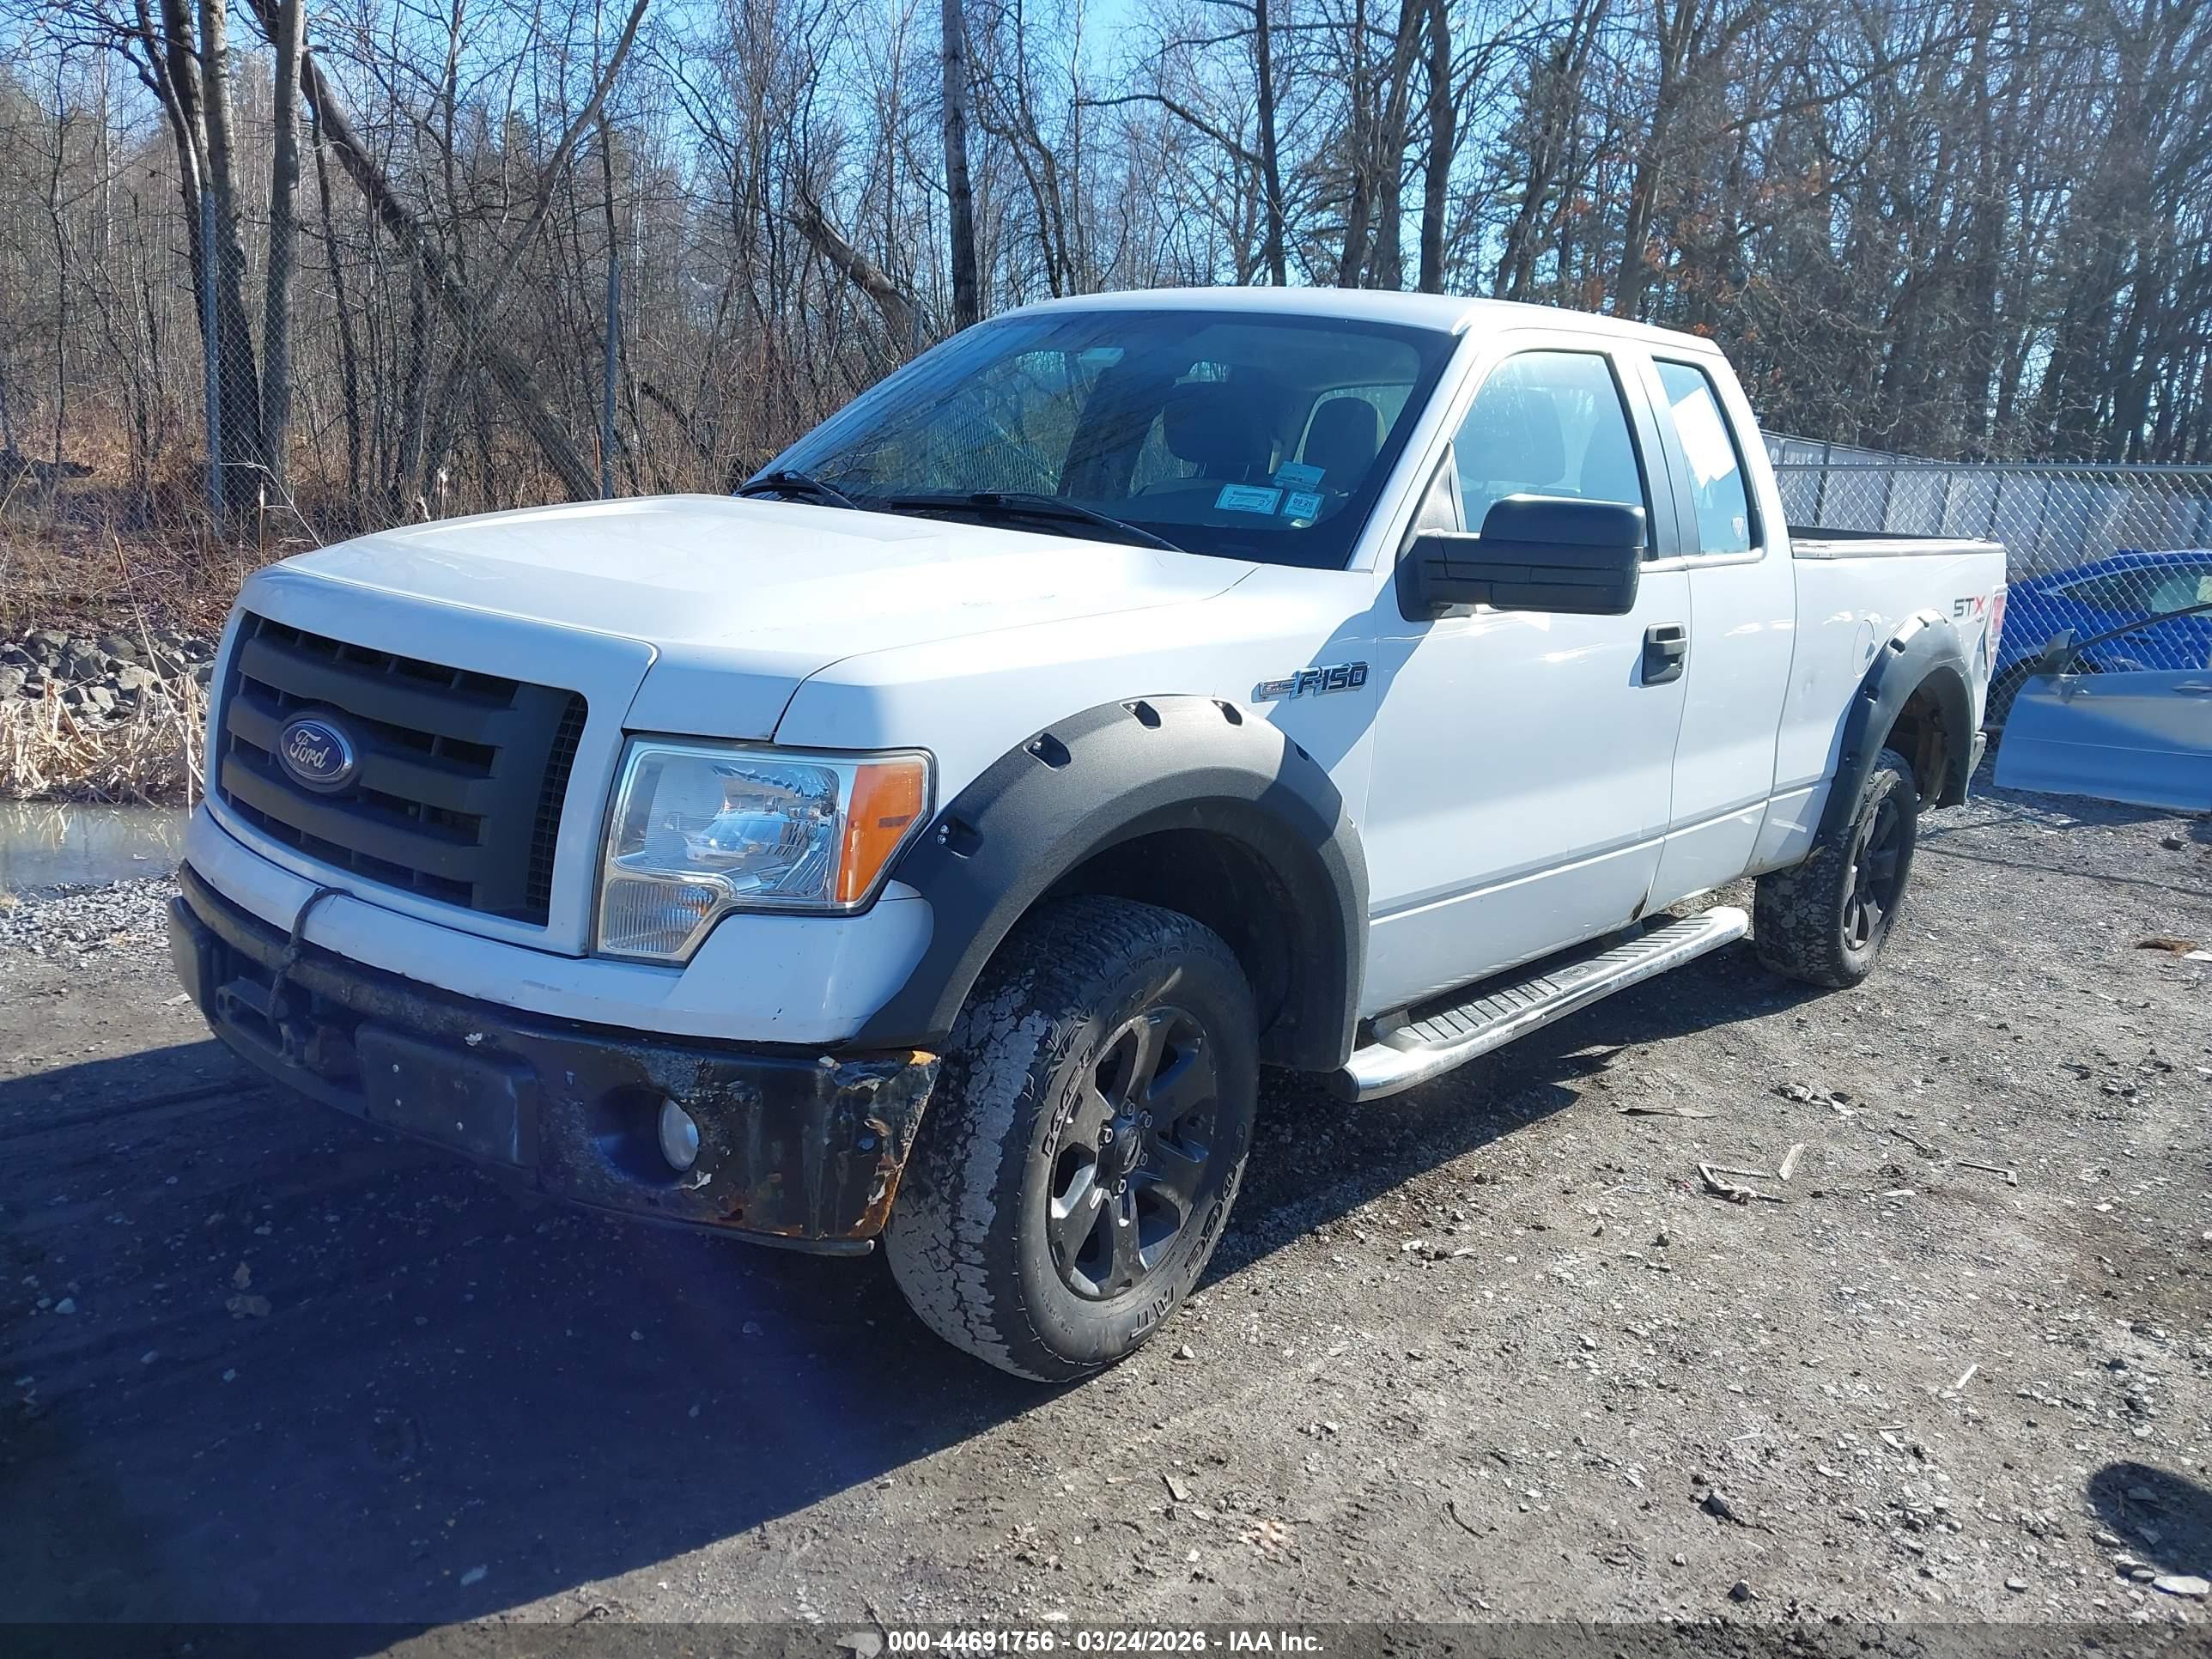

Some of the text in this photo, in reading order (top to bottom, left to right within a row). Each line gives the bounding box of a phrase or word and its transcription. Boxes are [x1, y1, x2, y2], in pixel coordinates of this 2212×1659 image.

[1293, 497, 1303, 506] 09
[1954, 596, 1985, 617] STX
[289, 729, 330, 769] Ford
